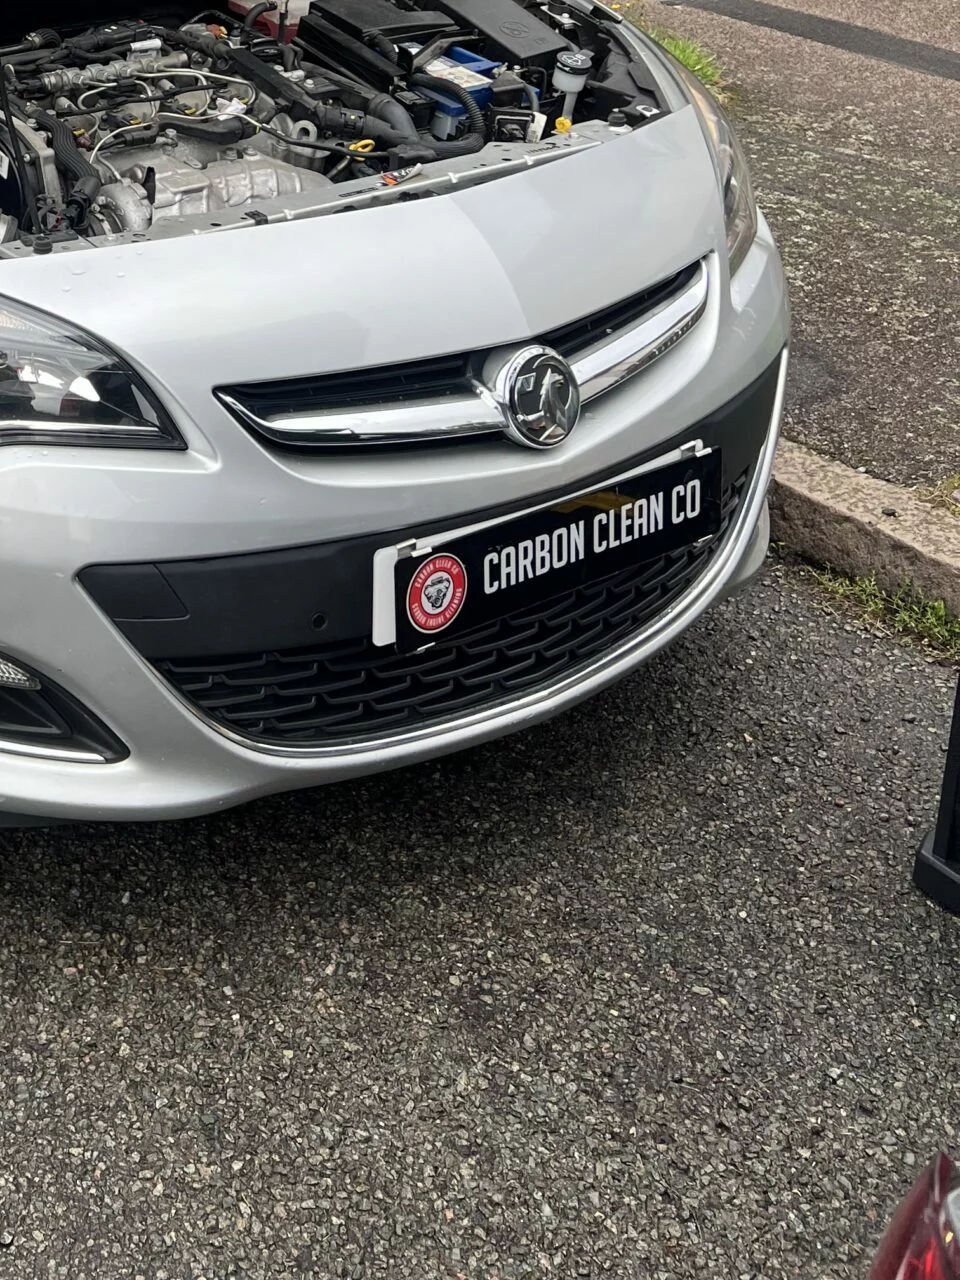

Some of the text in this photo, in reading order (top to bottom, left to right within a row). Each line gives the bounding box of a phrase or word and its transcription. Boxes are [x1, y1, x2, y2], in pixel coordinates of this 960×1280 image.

[483, 478, 701, 595] CARBON CLEAN CO
